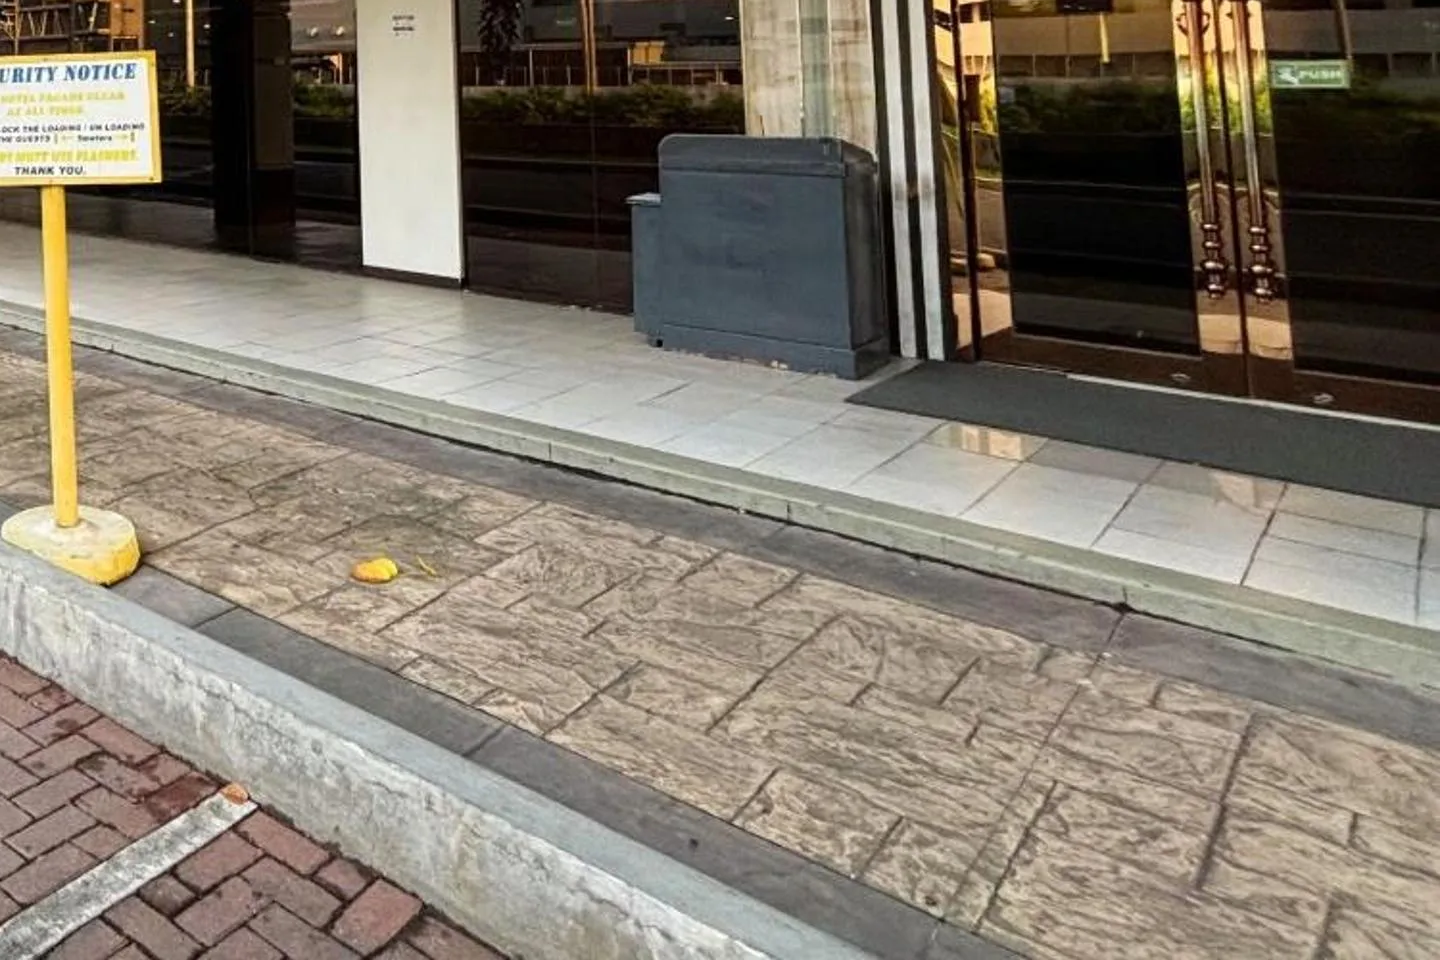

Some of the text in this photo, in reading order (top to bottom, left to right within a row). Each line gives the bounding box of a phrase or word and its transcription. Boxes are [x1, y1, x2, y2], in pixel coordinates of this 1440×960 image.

[63, 63, 137, 81] NOTICE
[1299, 69, 1342, 78] PUSH
[23, 125, 39, 133] THE
[42, 124, 81, 132] LOADING
[105, 122, 145, 131] LOADING
[16, 134, 51, 143] GUESTS
[15, 165, 87, 176] THANK YOU.
